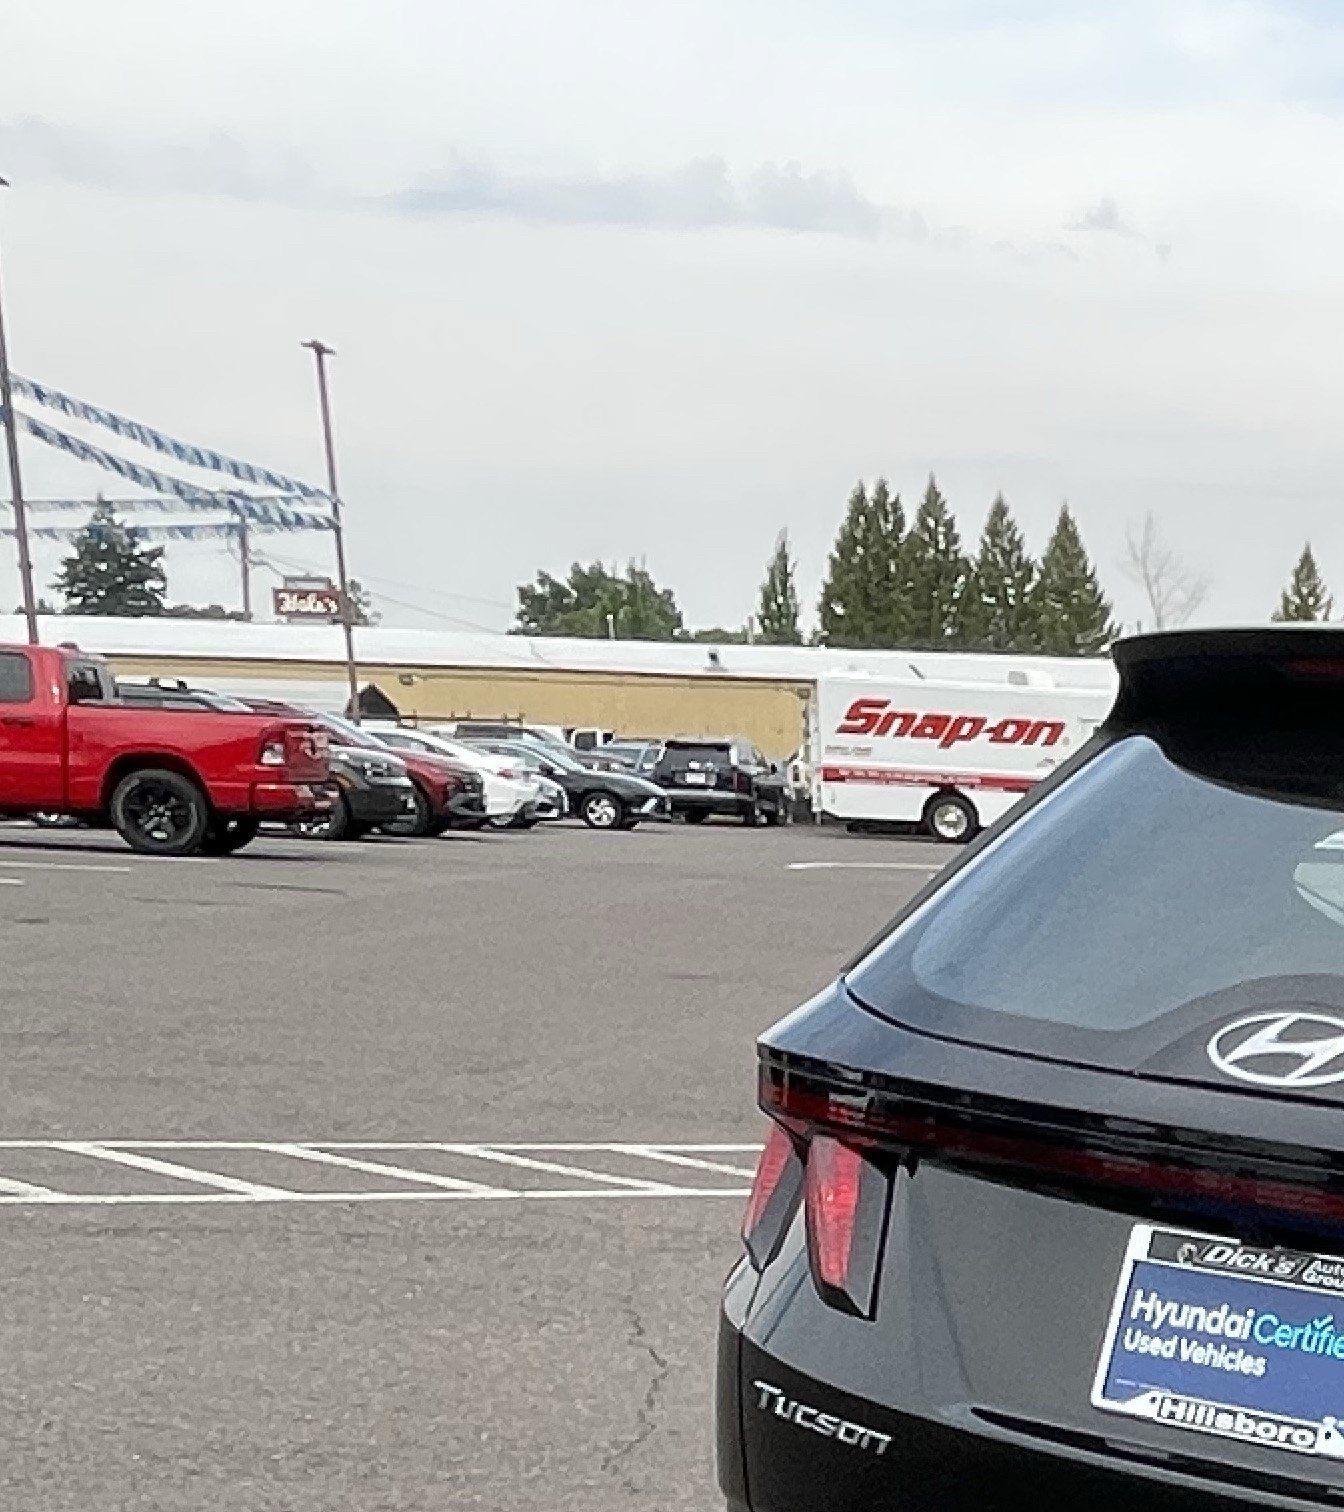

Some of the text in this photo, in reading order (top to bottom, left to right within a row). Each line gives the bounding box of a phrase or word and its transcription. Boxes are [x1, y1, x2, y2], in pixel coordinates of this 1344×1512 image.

[834, 698, 1066, 749] Snap-on
[1203, 1245, 1297, 1274] Dick's
[1123, 1327, 1268, 1377] Used Vehicles
[1161, 1396, 1316, 1447] Hillsboro
